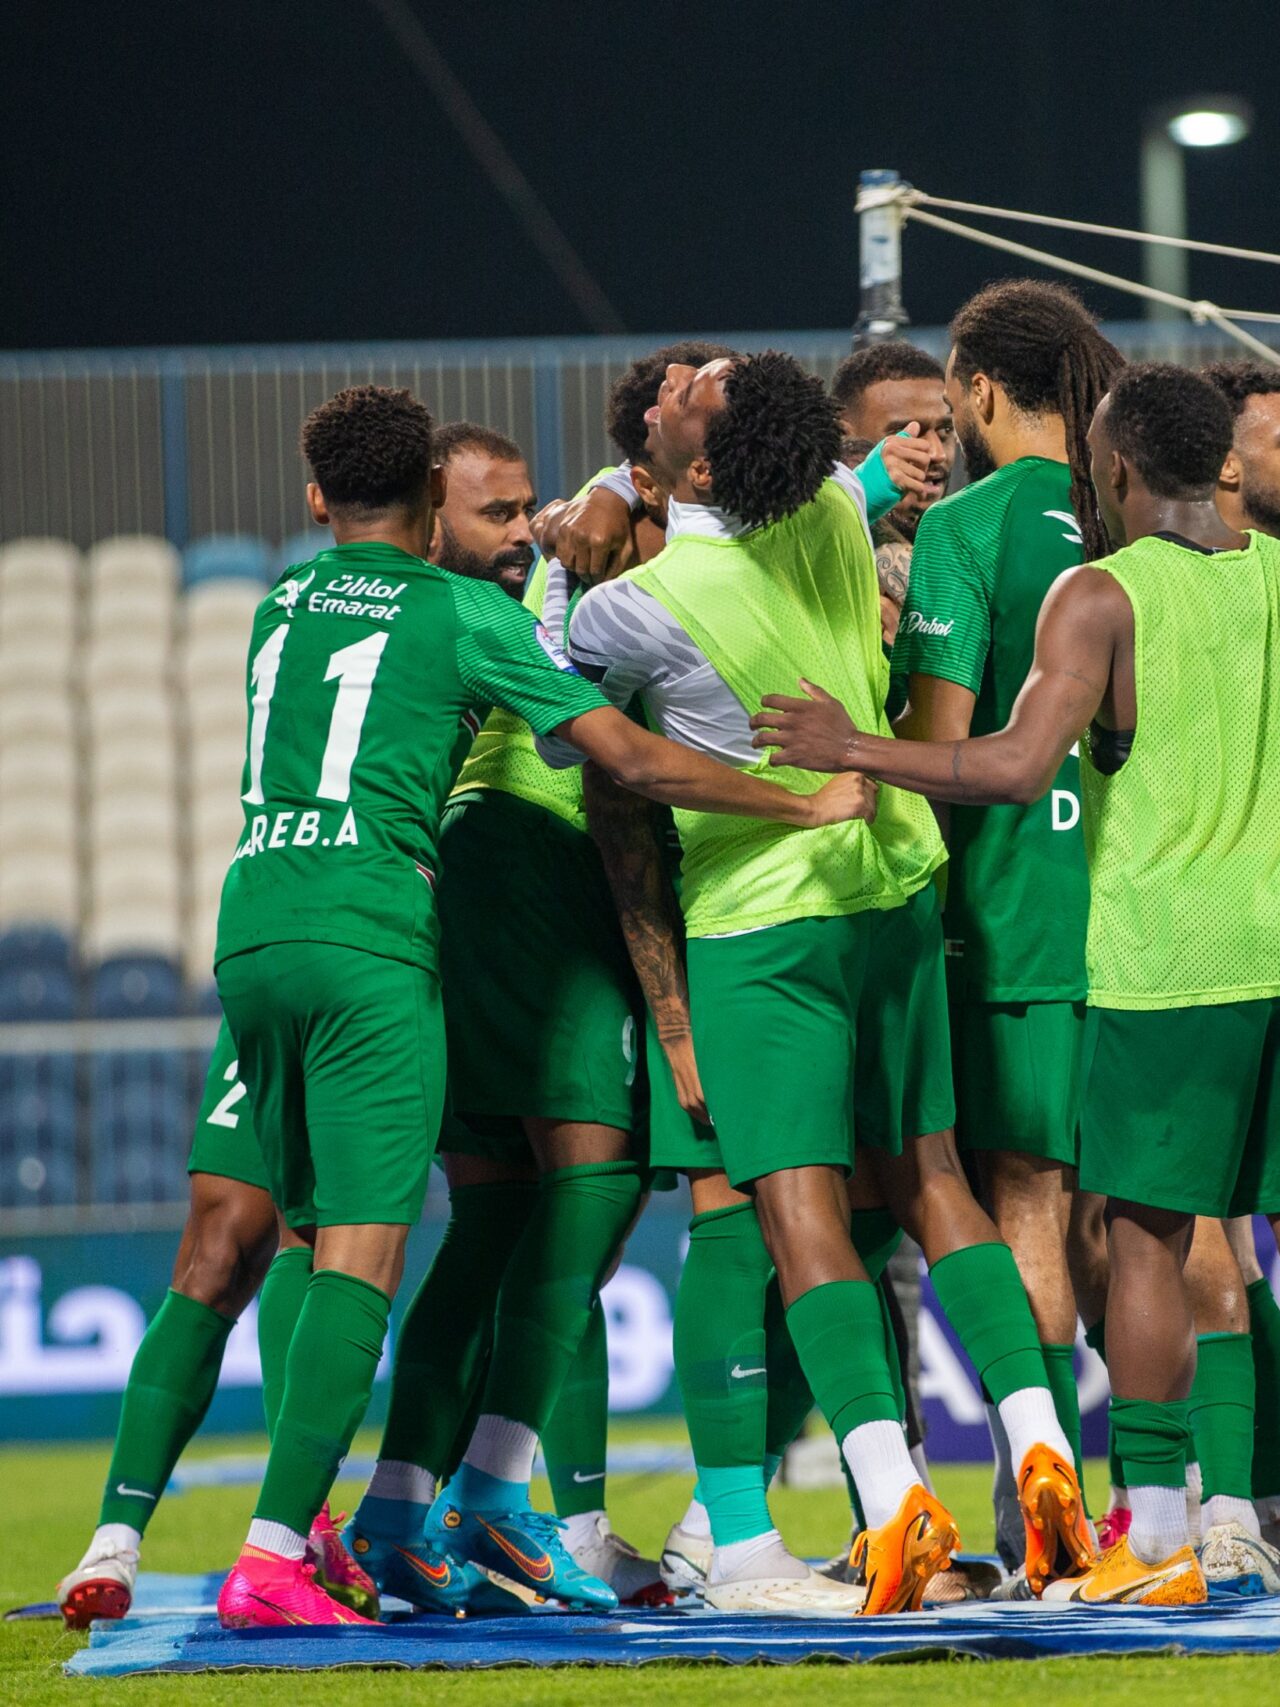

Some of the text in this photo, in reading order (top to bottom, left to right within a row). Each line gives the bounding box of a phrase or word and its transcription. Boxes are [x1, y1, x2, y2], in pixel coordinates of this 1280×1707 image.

[308, 592, 402, 620] Emarat
[908, 611, 954, 636] Dubai
[241, 623, 389, 803] 11
